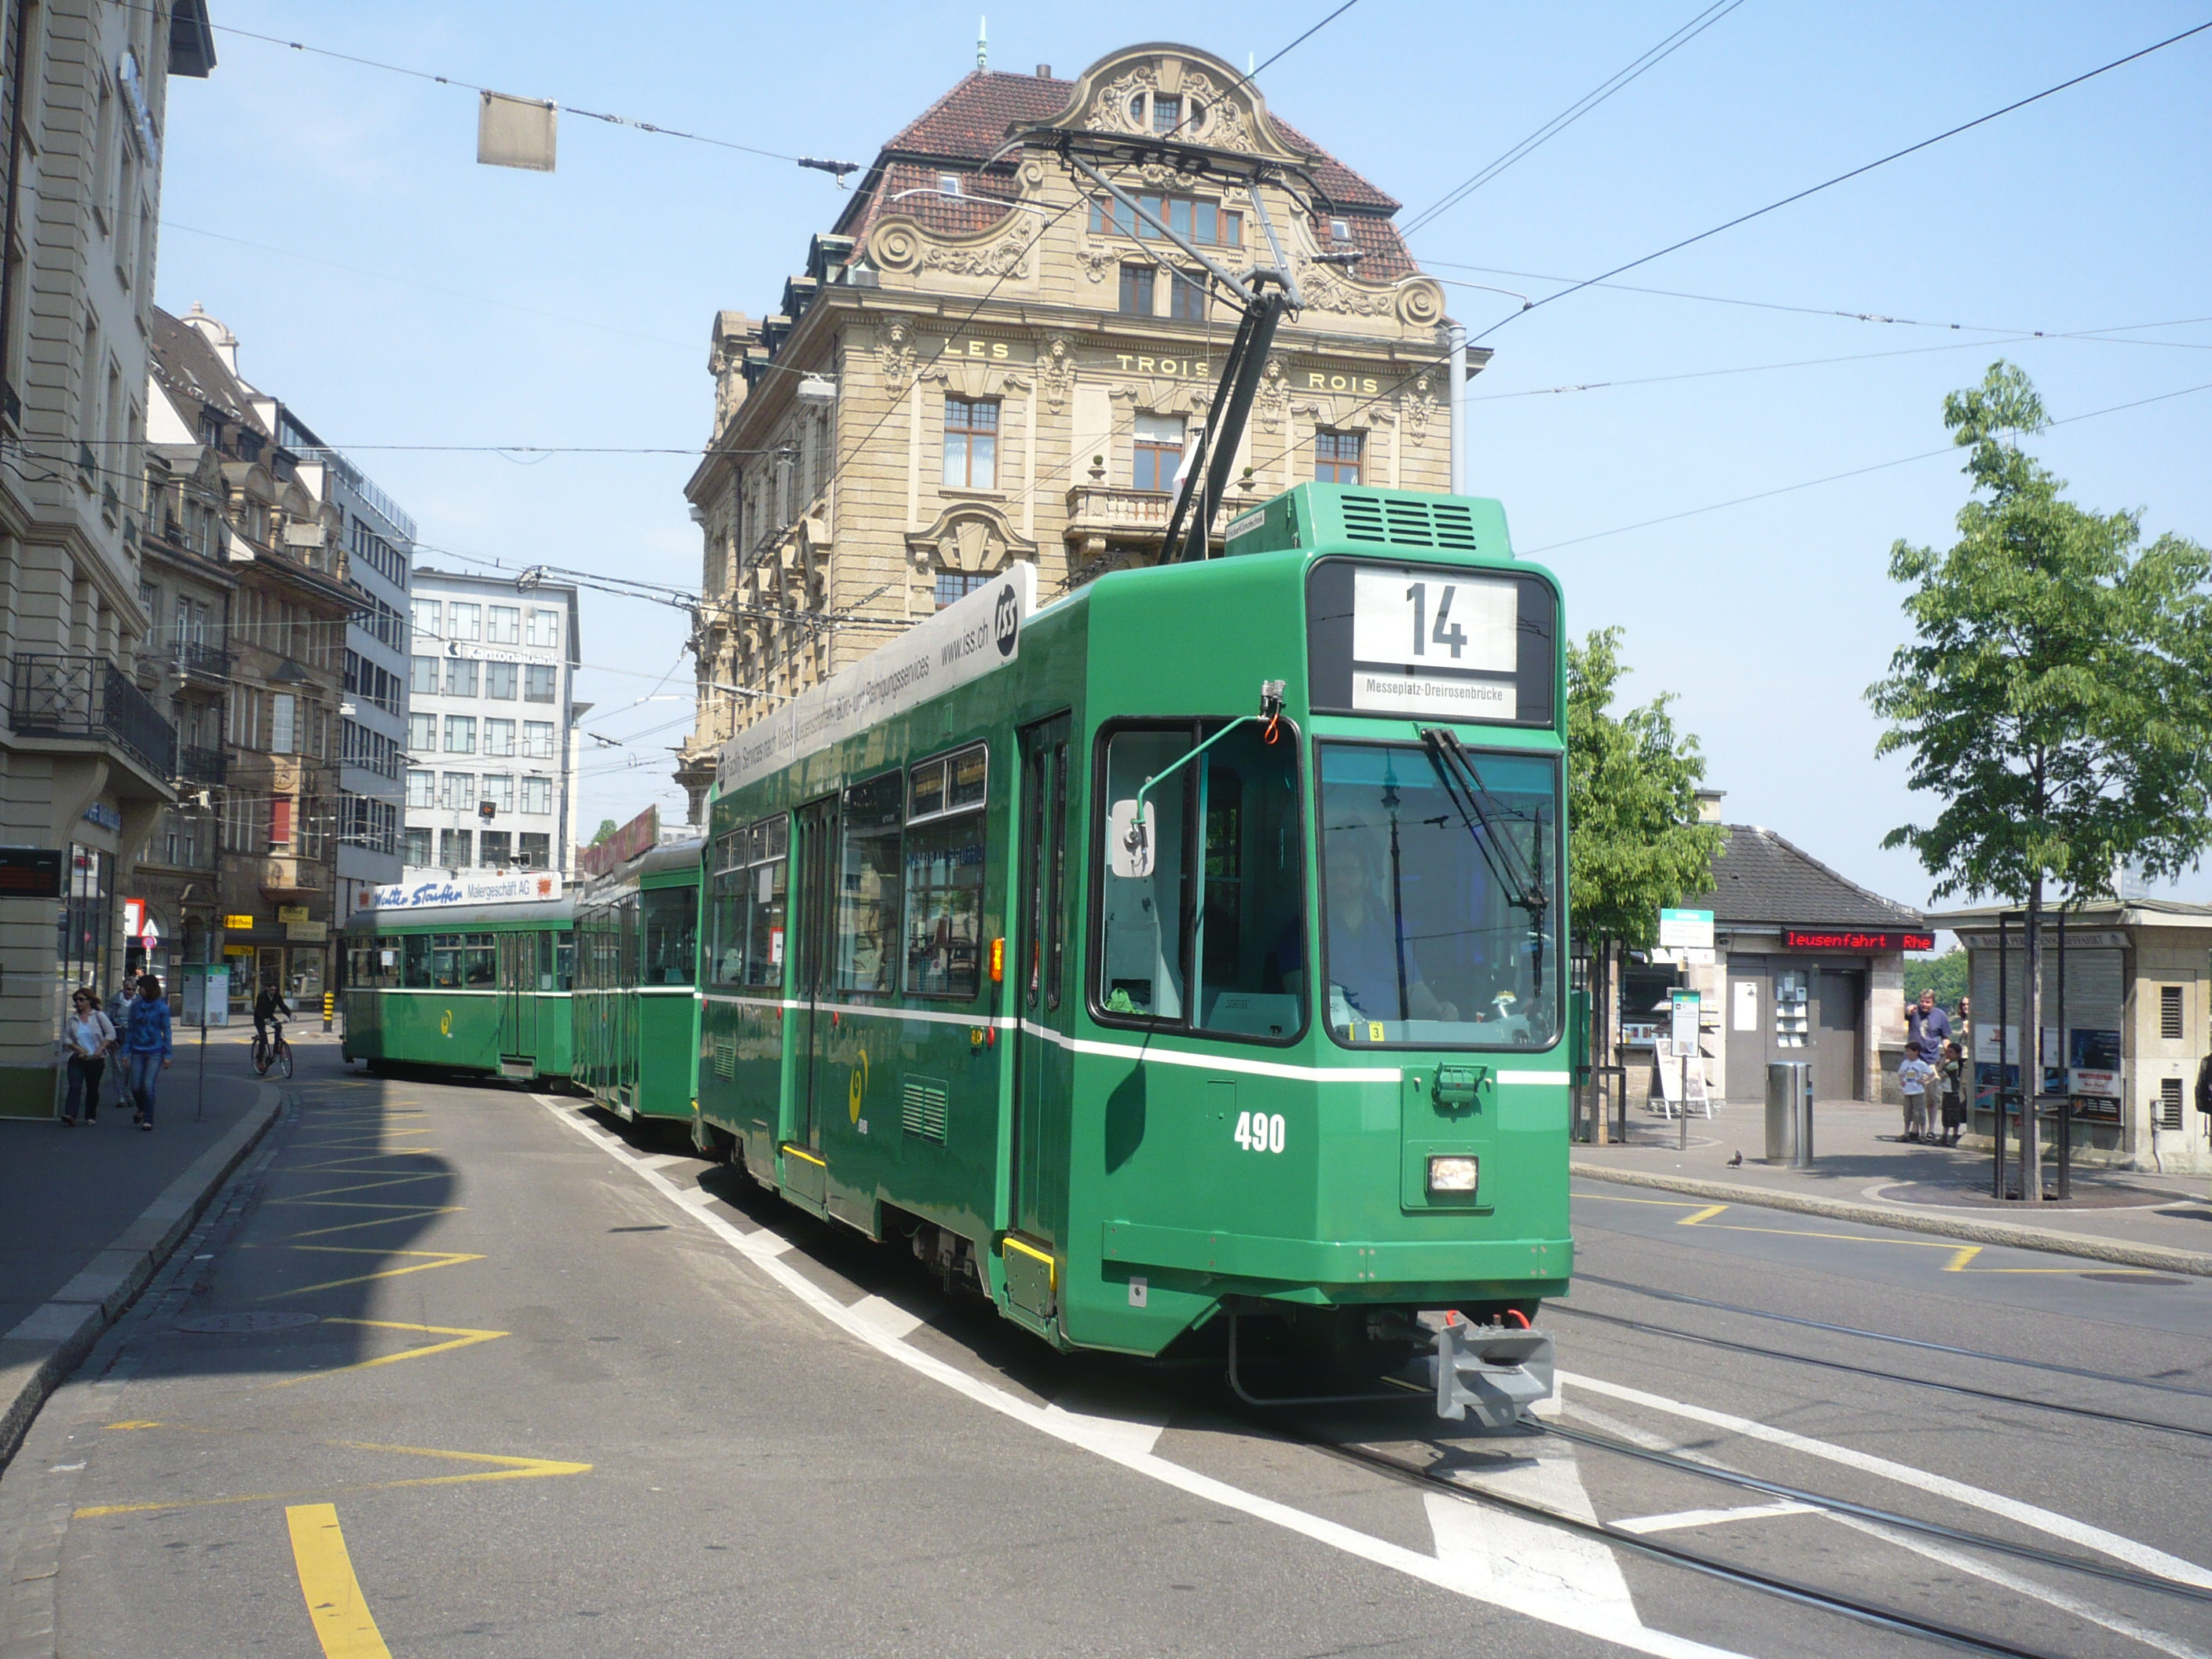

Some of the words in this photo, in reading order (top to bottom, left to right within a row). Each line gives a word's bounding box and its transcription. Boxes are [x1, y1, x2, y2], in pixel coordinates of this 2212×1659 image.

[944, 341, 1009, 359] LES
[1116, 354, 1211, 377] TROIS
[1309, 372, 1379, 394] ROIS
[1406, 582, 1467, 658] 14
[467, 646, 558, 666] Kantonalbank
[742, 742, 764, 771] Services
[764, 729, 777, 758] nach
[866, 654, 930, 706] Reinigungsservices
[942, 617, 989, 667] www.iss.ch
[1367, 679, 1503, 701] Messeplatz-Dreirosenbrücke
[375, 886, 408, 906] Walter
[411, 883, 463, 906] Stauffer
[468, 880, 517, 899] Malergeschäft
[518, 880, 530, 895] AG
[1788, 932, 1886, 947] leusenfahrt
[1903, 935, 1930, 949] Rhe
[1373, 1027, 1379, 1038] 3
[1234, 1111, 1285, 1154] 490
